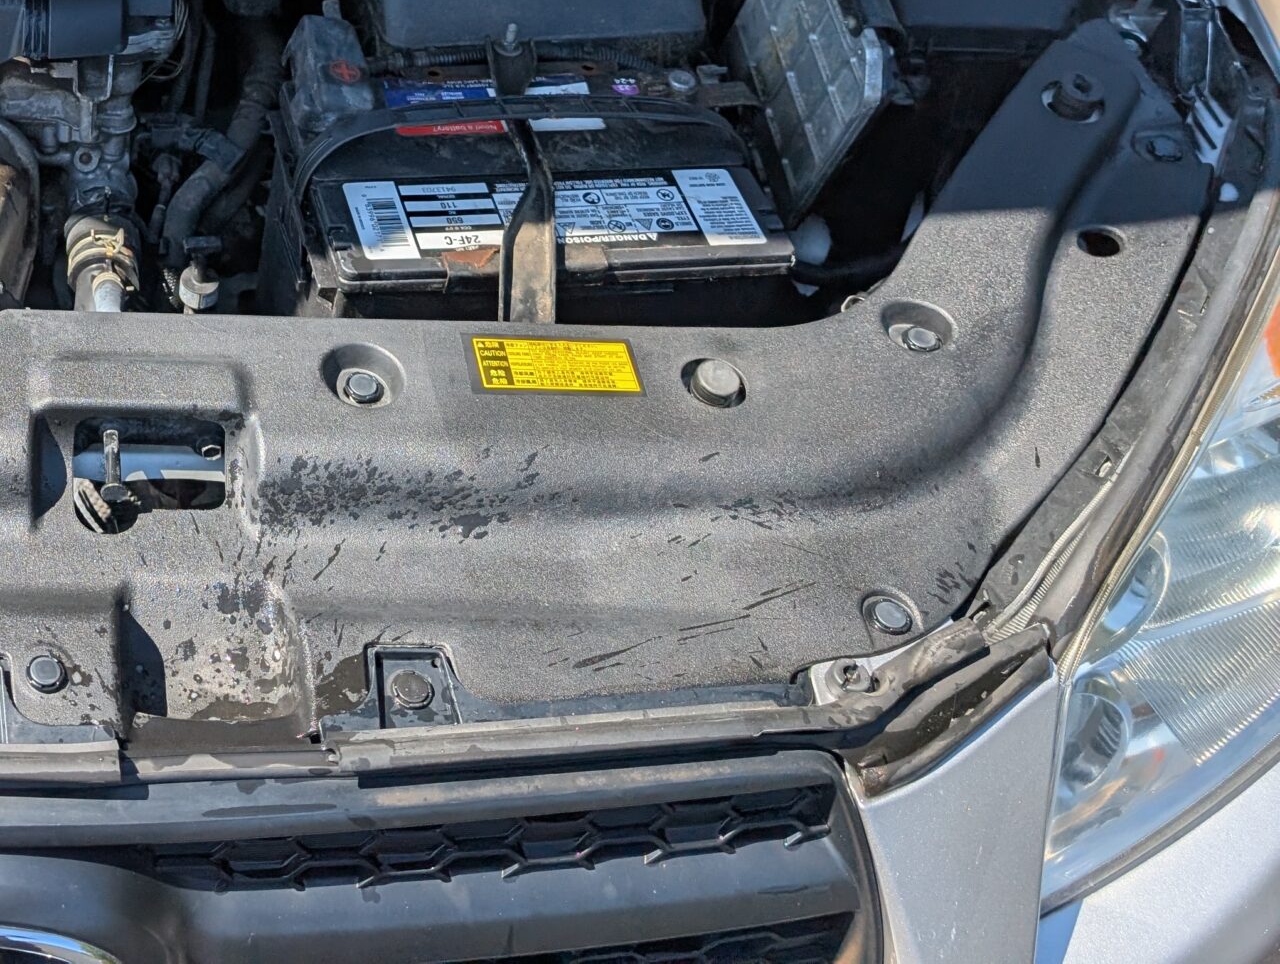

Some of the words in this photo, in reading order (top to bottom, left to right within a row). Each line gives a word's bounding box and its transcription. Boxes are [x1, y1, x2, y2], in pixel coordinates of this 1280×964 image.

[432, 124, 467, 133] battery?
[439, 201, 457, 209] 110
[446, 216, 464, 225] 650
[443, 234, 481, 246] 24F-C
[557, 233, 649, 245] DANGER/POISON
[479, 349, 506, 357] CAUTION
